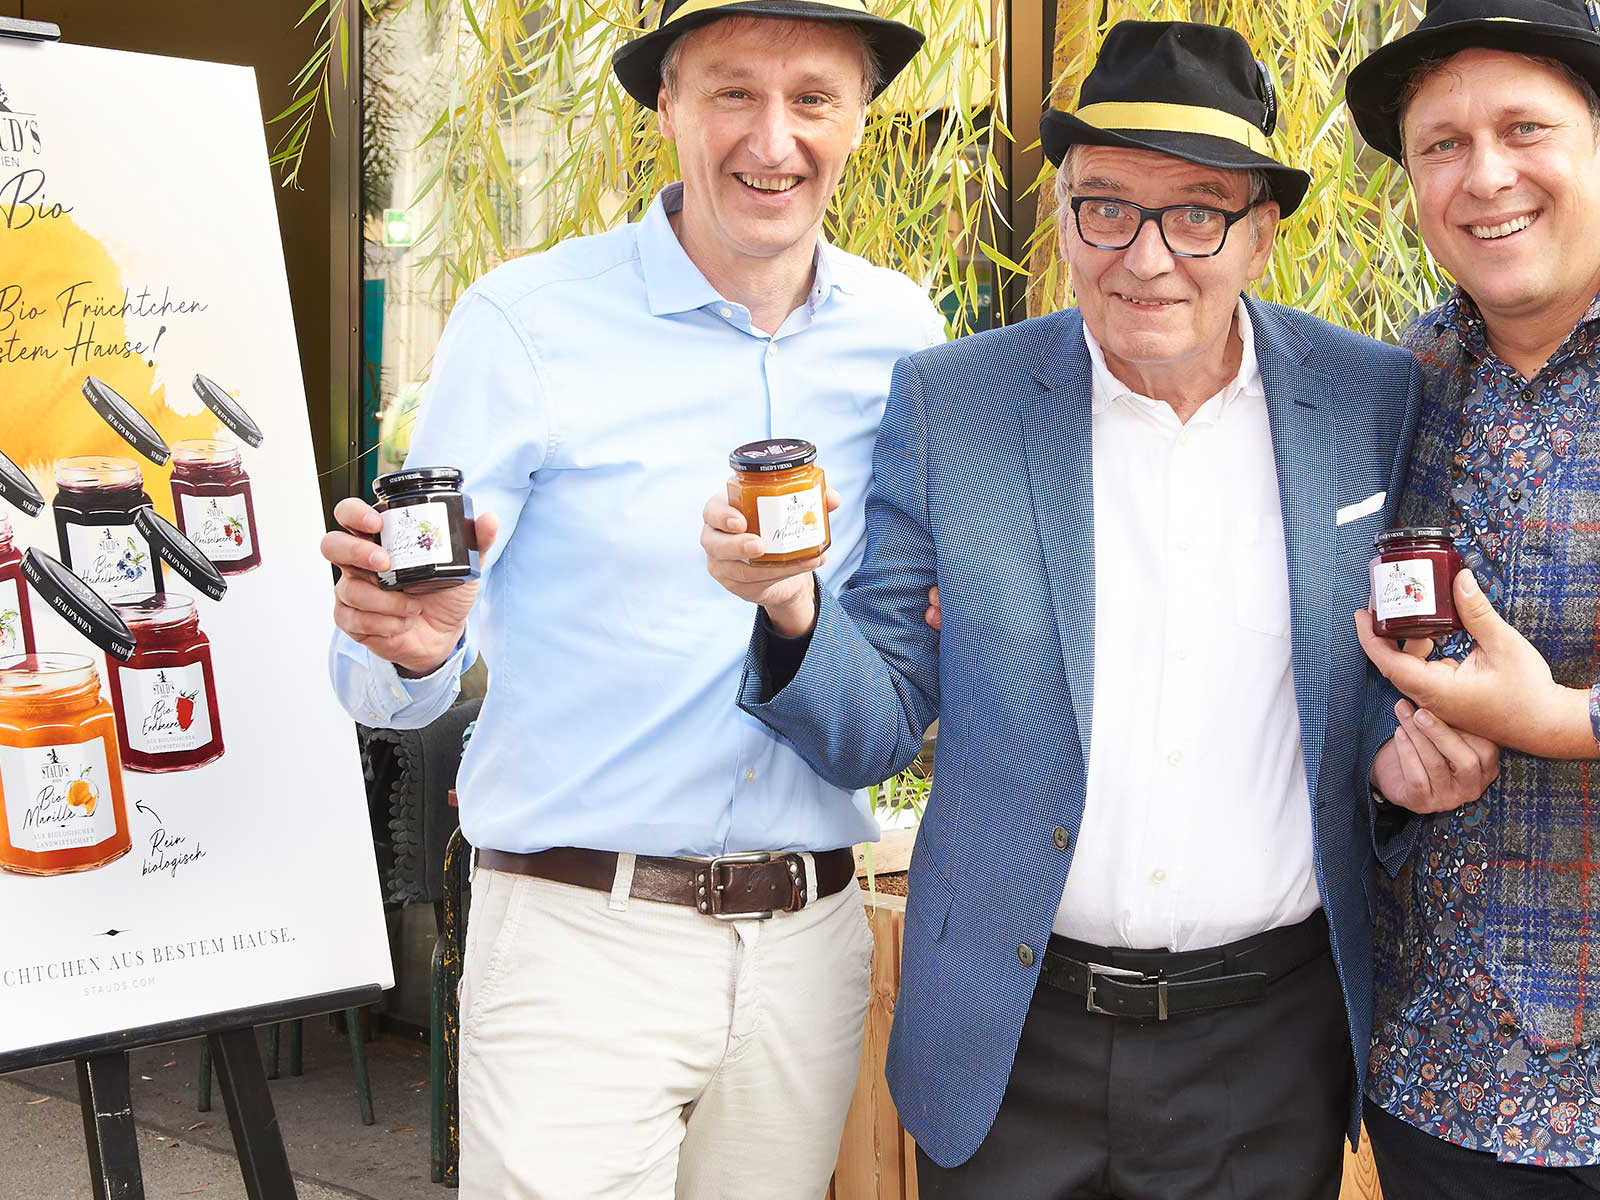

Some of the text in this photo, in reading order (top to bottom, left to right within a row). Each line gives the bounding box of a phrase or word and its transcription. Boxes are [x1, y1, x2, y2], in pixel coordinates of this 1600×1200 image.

[0, 168, 74, 230] Bio
[0, 280, 209, 331] Bio Früchtchen
[64, 321, 167, 368] Hause!
[93, 554, 115, 574] Bio
[53, 595, 79, 621] STAUD'S
[76, 615, 93, 634] WIEN
[151, 699, 174, 720] Bio
[142, 715, 180, 736] Erdbeere
[41, 764, 70, 779] STAUD'S
[36, 785, 66, 811] Bio
[22, 804, 77, 831] Marille
[148, 828, 186, 857] Rein
[142, 841, 207, 879] biologisch
[2, 927, 297, 988] CHTCHEN AUS BESTEM HAUSE.
